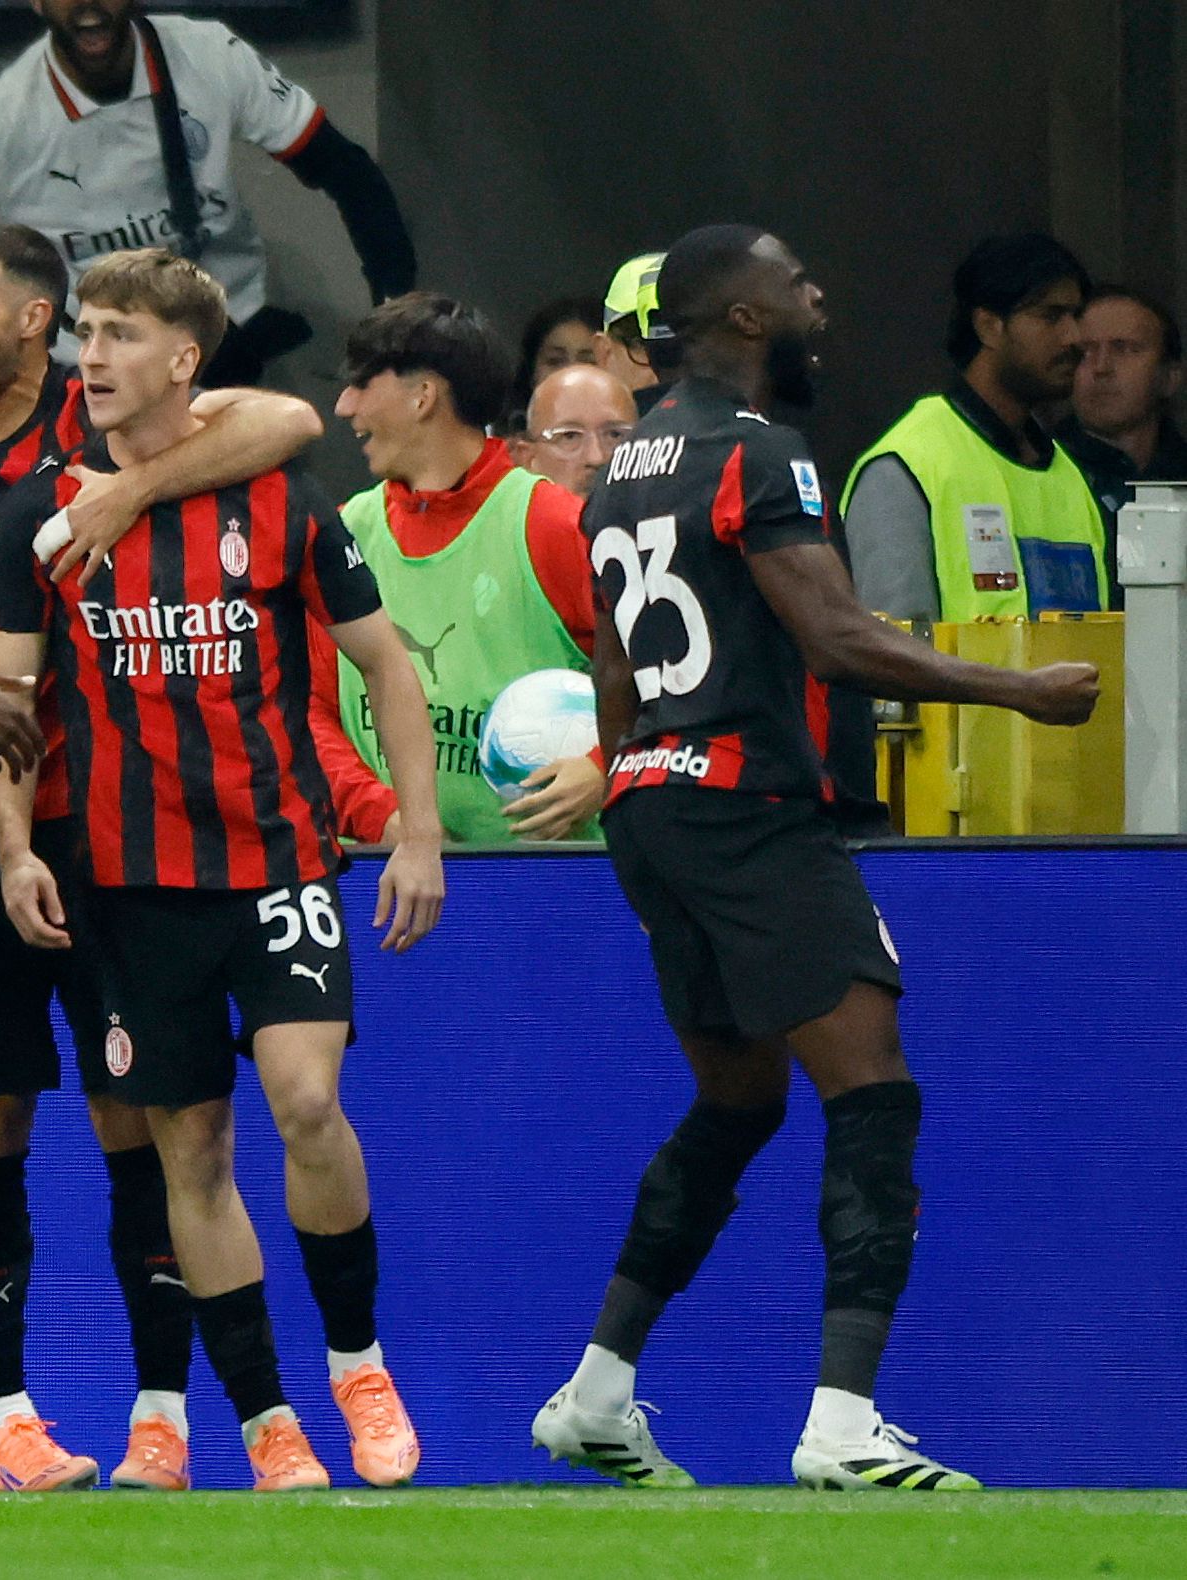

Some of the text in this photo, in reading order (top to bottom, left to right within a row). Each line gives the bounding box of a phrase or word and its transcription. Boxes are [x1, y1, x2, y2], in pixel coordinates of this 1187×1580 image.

[61, 189, 228, 262] Emiras
[77, 596, 259, 640] Emirates
[590, 514, 712, 703] 23
[113, 639, 243, 677] FLY BETTER
[256, 884, 341, 953] 56
